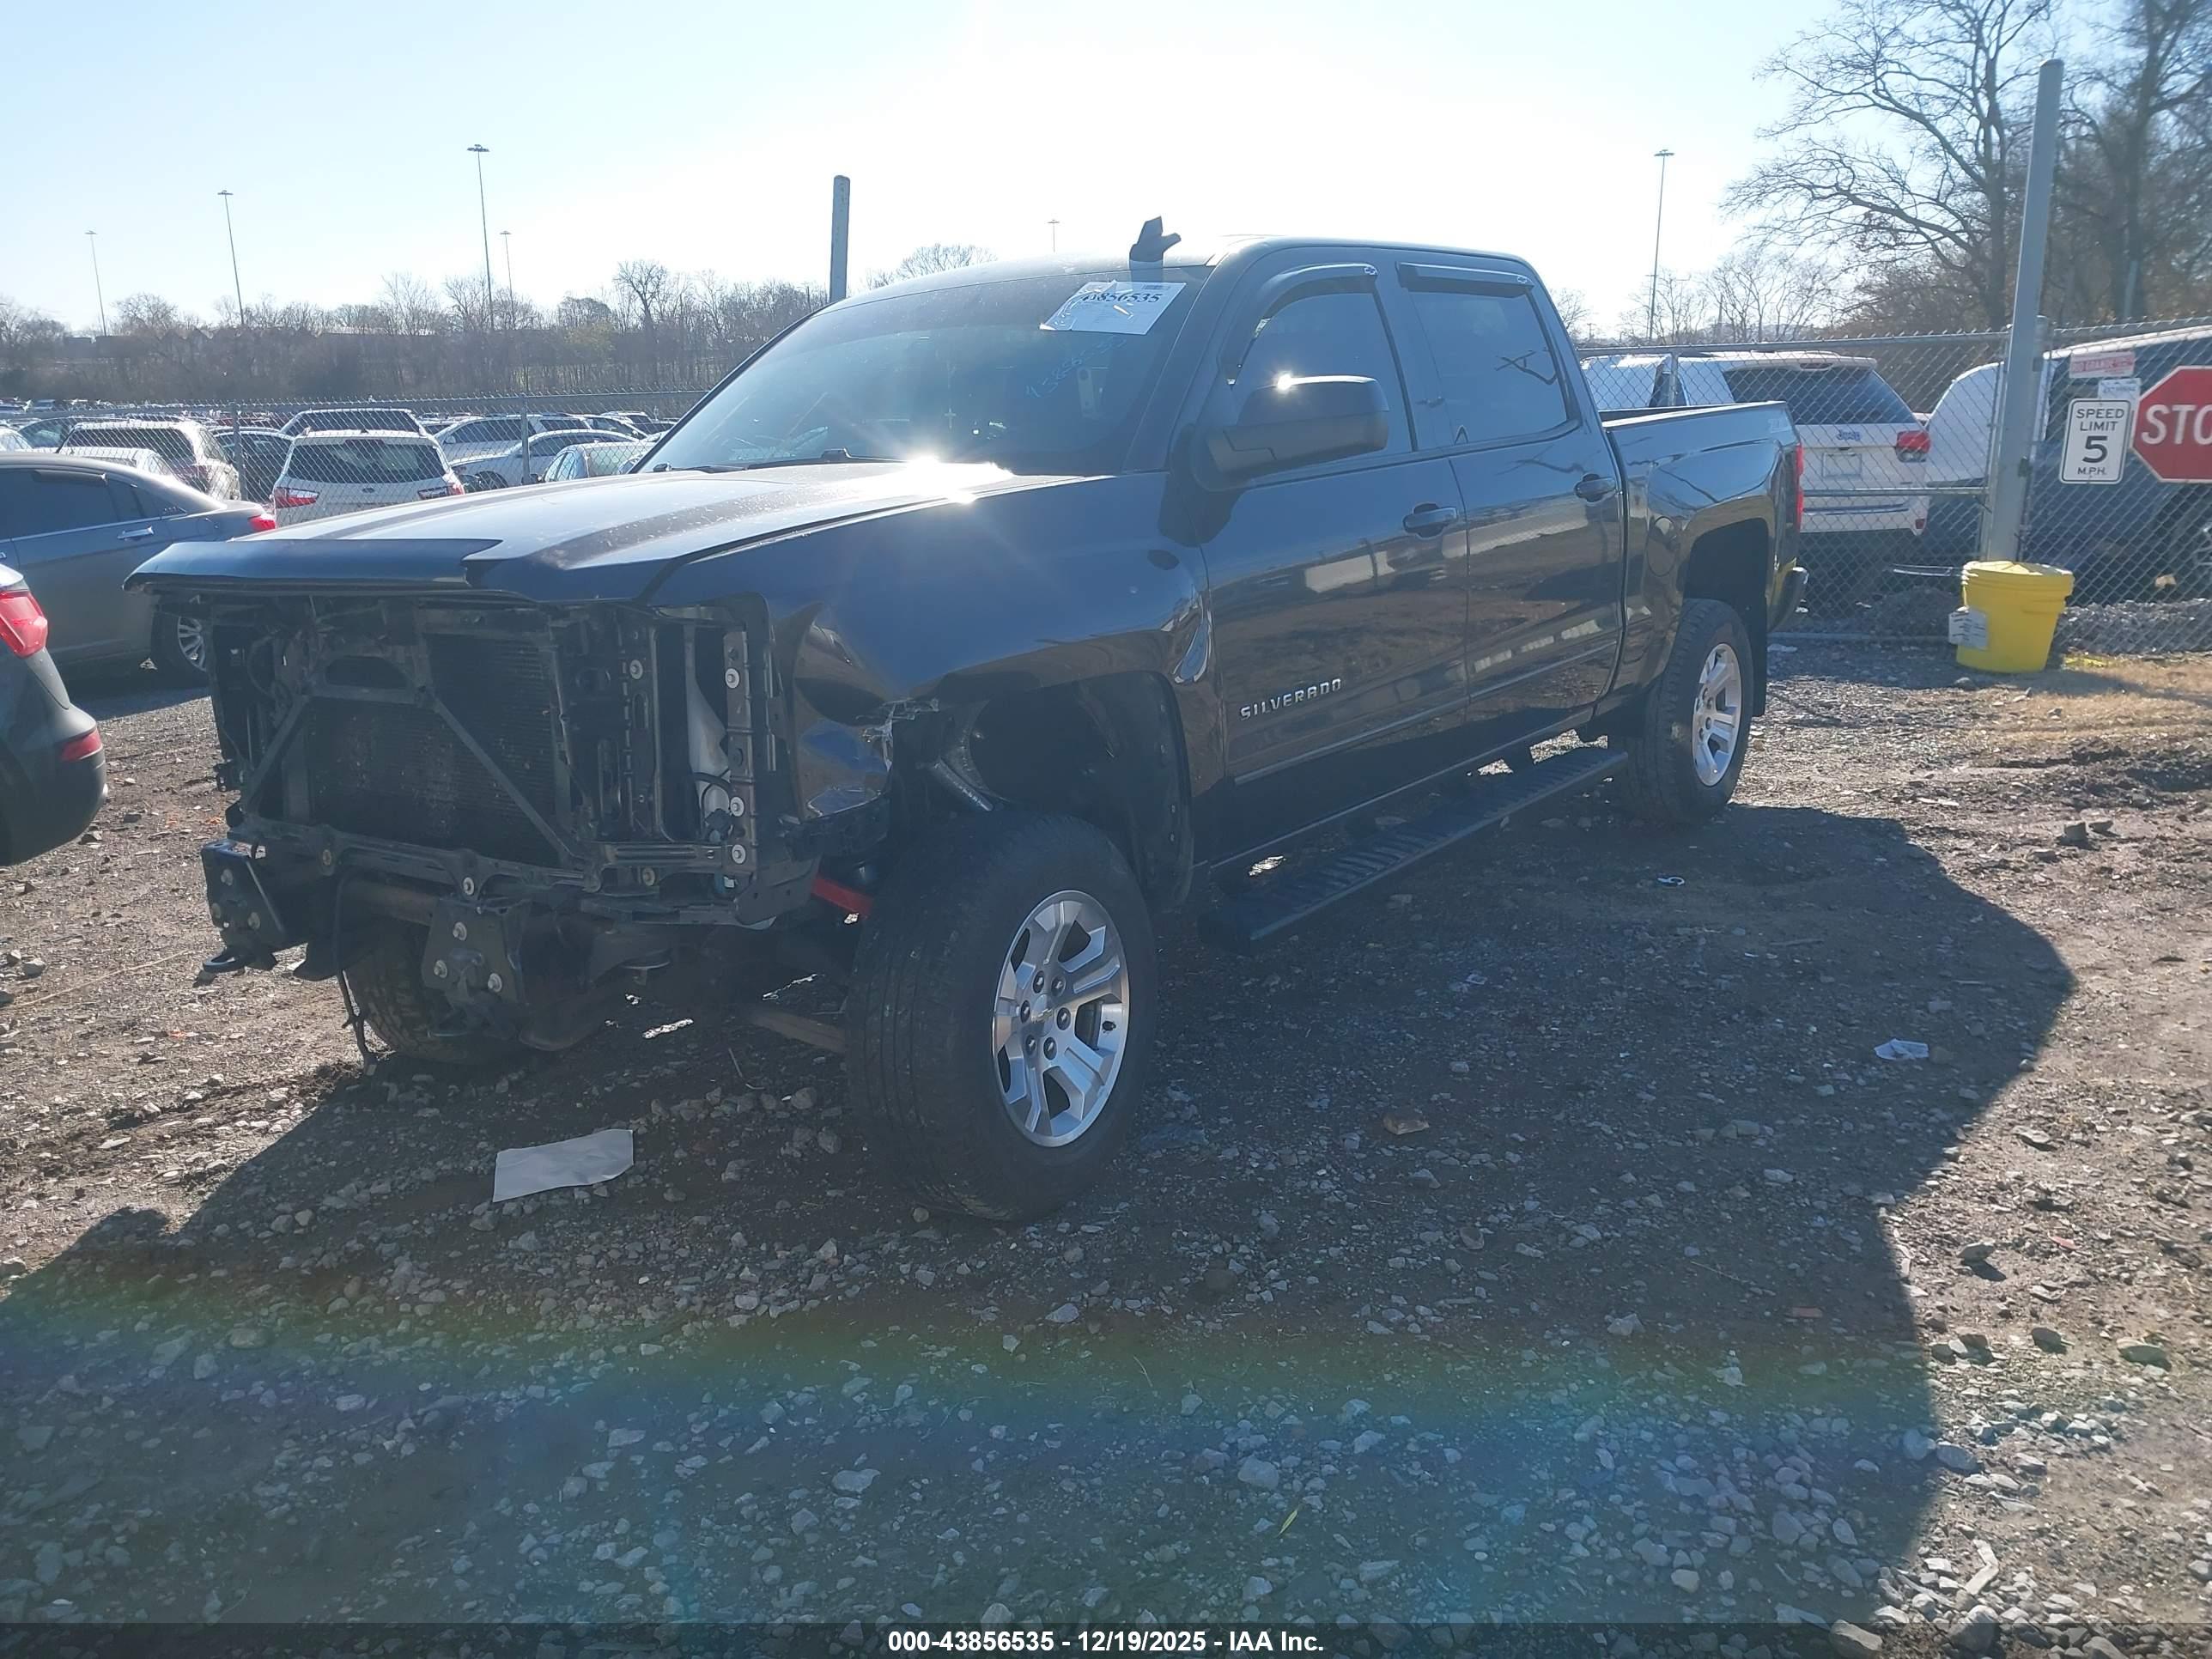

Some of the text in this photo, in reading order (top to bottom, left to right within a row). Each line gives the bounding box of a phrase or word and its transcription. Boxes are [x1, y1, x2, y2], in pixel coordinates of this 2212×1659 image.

[1081, 292, 1162, 304] 856535
[2075, 409, 2125, 419] SPEED
[2080, 422, 2118, 432] LIMIT
[1836, 430, 1861, 441] Jeep
[2081, 435, 2108, 464] 5
[1240, 678, 1341, 720] SILVERADO
